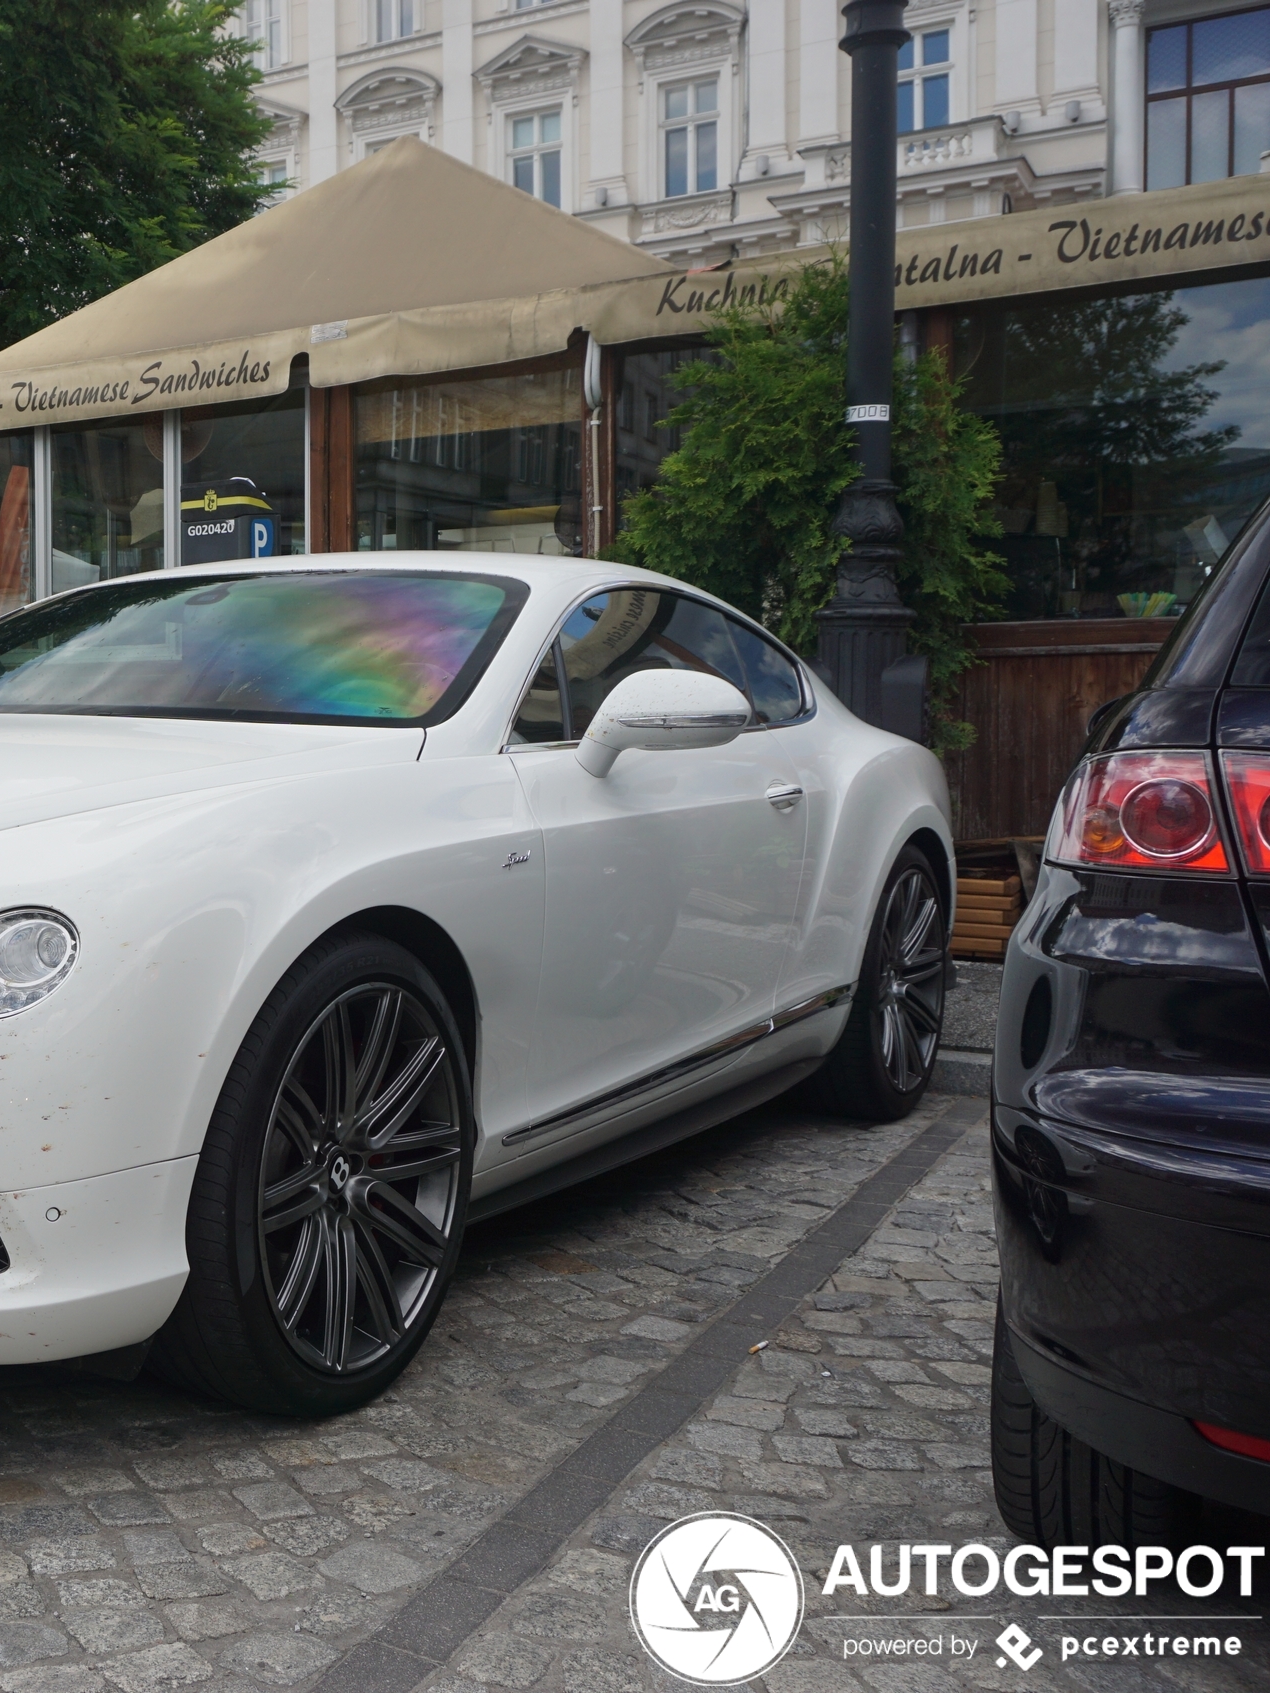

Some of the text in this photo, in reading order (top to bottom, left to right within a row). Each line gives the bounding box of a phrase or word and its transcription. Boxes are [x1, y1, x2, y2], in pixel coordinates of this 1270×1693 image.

[656, 271, 789, 316] Kuchnia
[1048, 211, 1270, 263] Vietnames
[11, 379, 130, 413] Vietnamese
[131, 350, 271, 405] Sandwiches
[187, 522, 235, 537] G020420
[254, 522, 268, 558] P
